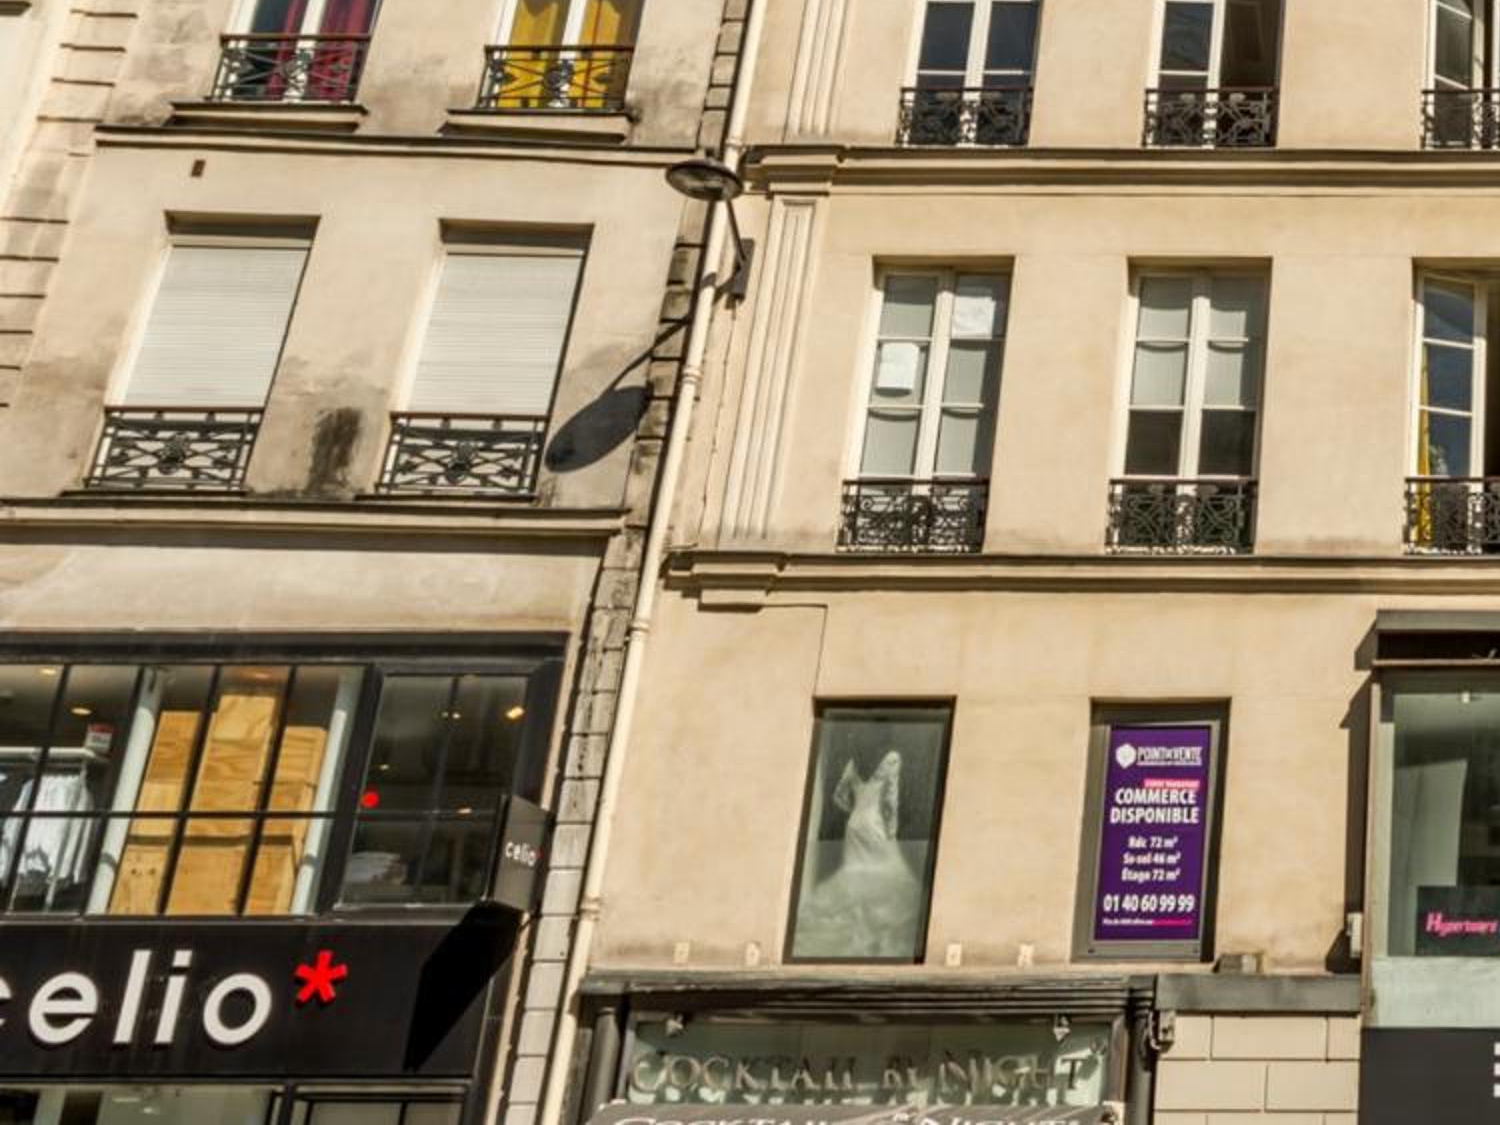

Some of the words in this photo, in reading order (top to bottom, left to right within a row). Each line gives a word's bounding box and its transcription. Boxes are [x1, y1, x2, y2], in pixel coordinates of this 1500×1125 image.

[1115, 787, 1197, 805] COMMERCE
[1109, 806, 1200, 824] DISPONIBLE
[1149, 836, 1162, 849] 72
[1151, 868, 1165, 882] 72
[1103, 894, 1119, 912] 01
[1121, 894, 1139, 912] 40
[1140, 894, 1158, 912] 60
[1159, 894, 1176, 912] 99
[1177, 894, 1195, 912] 99
[0, 949, 348, 1045] elio
